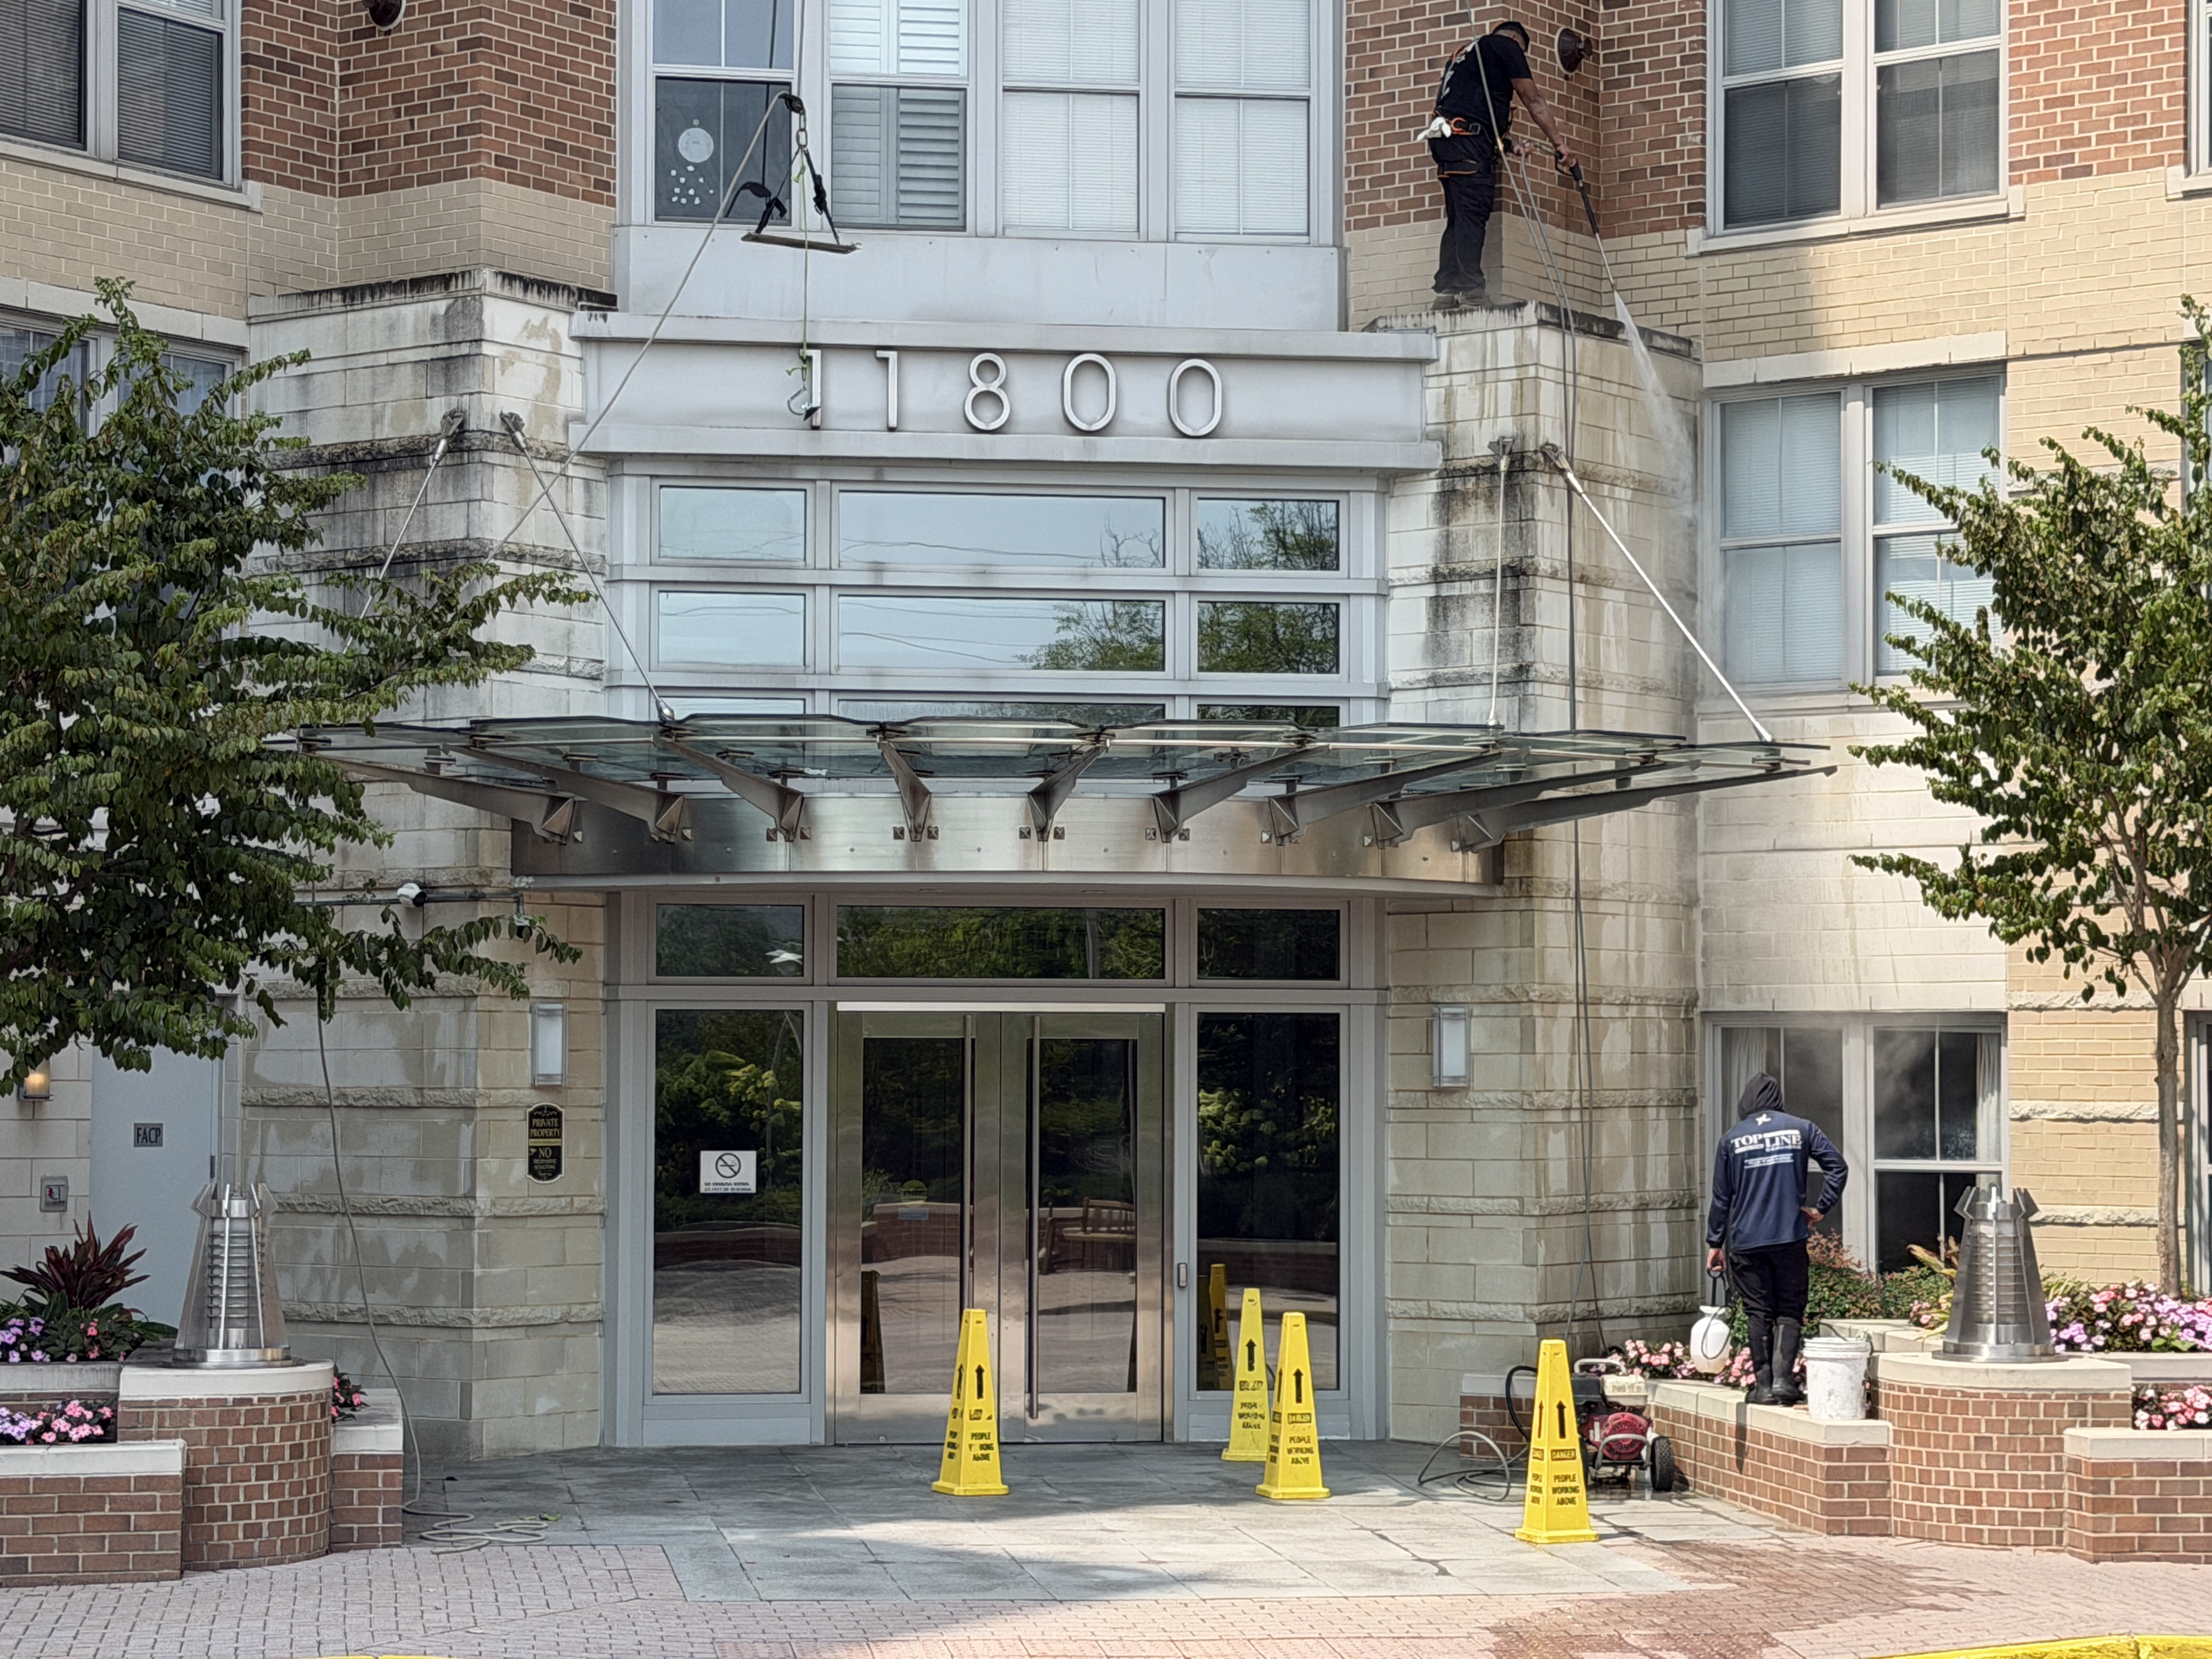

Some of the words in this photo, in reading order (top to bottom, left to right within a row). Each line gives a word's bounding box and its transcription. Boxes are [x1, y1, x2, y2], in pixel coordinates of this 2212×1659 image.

[799, 349, 1222, 437] 11800
[532, 1118, 559, 1127] PRIVATE
[137, 1127, 161, 1144] FACP
[531, 1128, 560, 1137] PROPERTY
[1730, 1133, 1763, 1148] TOP
[1765, 1135, 1802, 1147] LINE
[538, 1147, 552, 1159] NO
[1551, 1450, 1576, 1459] DANGER
[1553, 1474, 1576, 1483] PEOPLE
[1551, 1486, 1580, 1495] WORKING
[1556, 1497, 1577, 1506] ABOVE
